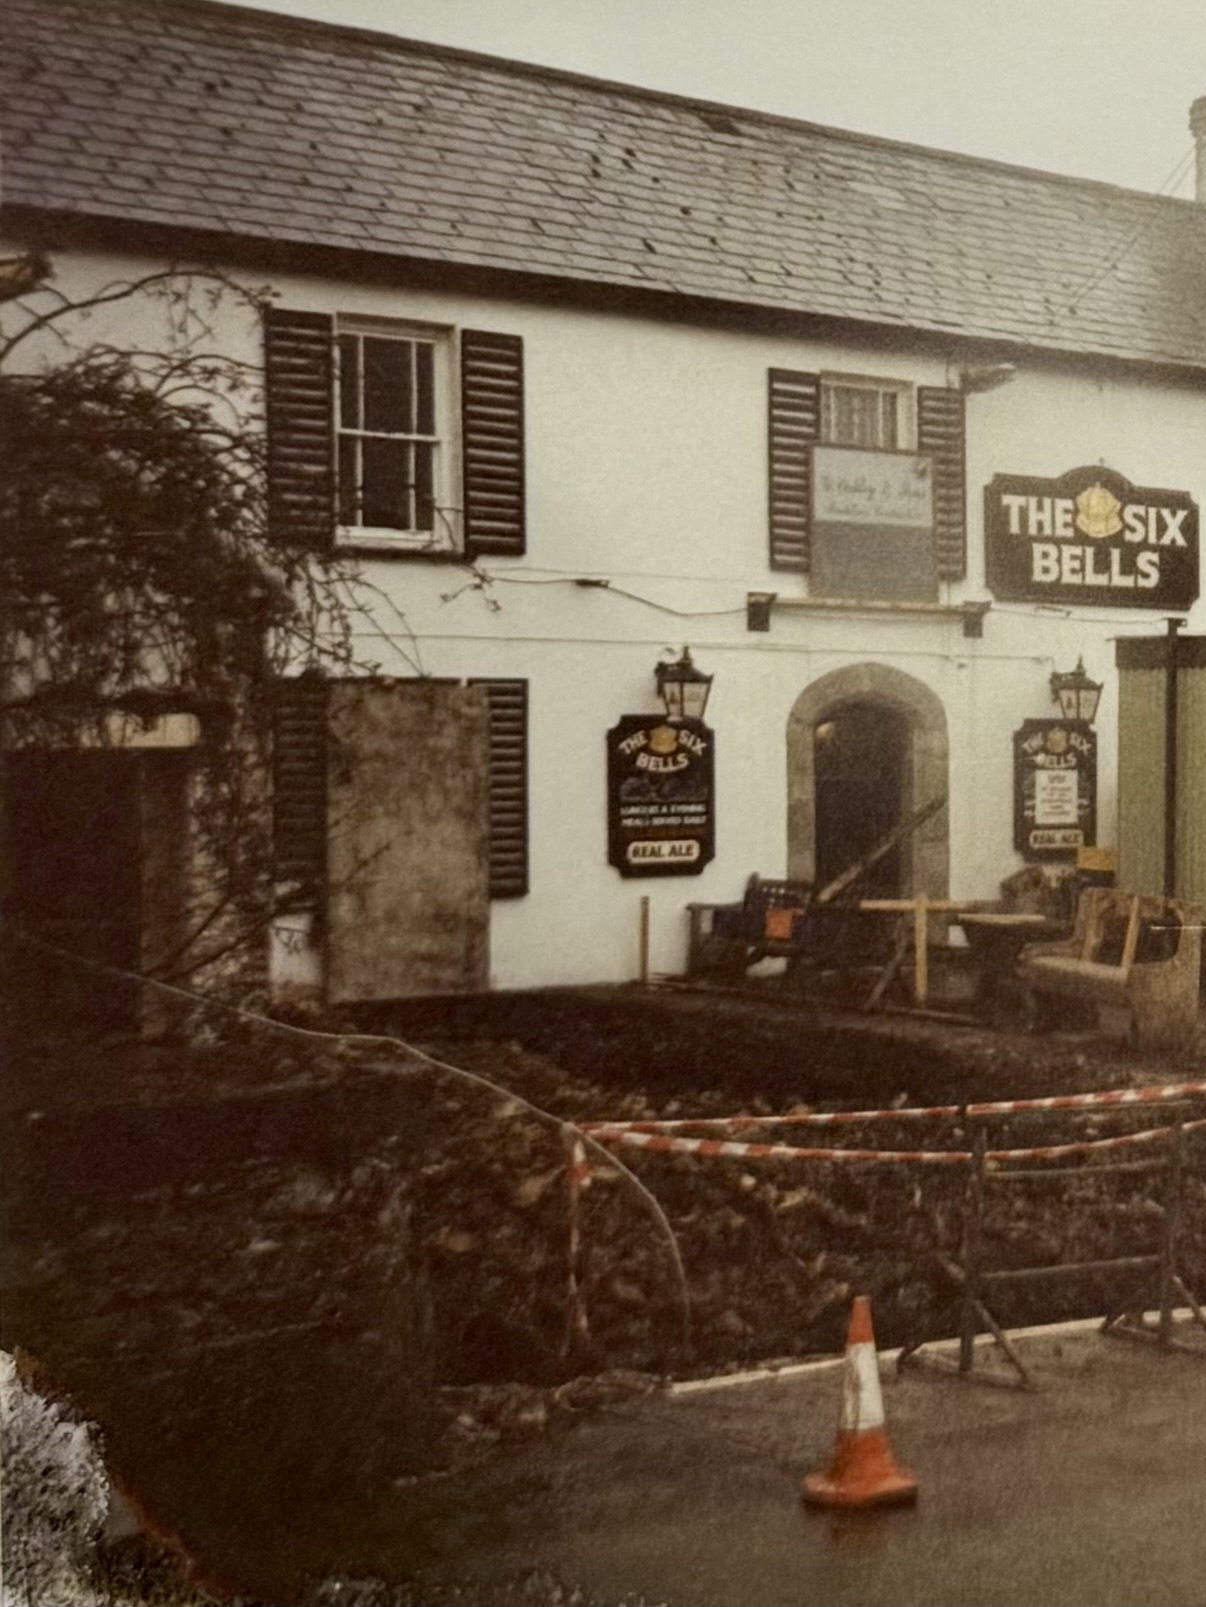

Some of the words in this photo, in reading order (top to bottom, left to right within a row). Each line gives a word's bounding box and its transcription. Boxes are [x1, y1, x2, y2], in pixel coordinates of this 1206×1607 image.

[1001, 494, 1075, 538] THE
[1122, 503, 1189, 548] SIX
[1031, 542, 1161, 589] BELLS
[619, 730, 647, 754] THE
[679, 729, 707, 756] SIX
[1022, 732, 1044, 753] THE
[636, 752, 689, 772] BELLS
[1036, 753, 1077, 769] BELLS
[631, 845, 664, 858] REAL
[668, 844, 694, 857] ALE
